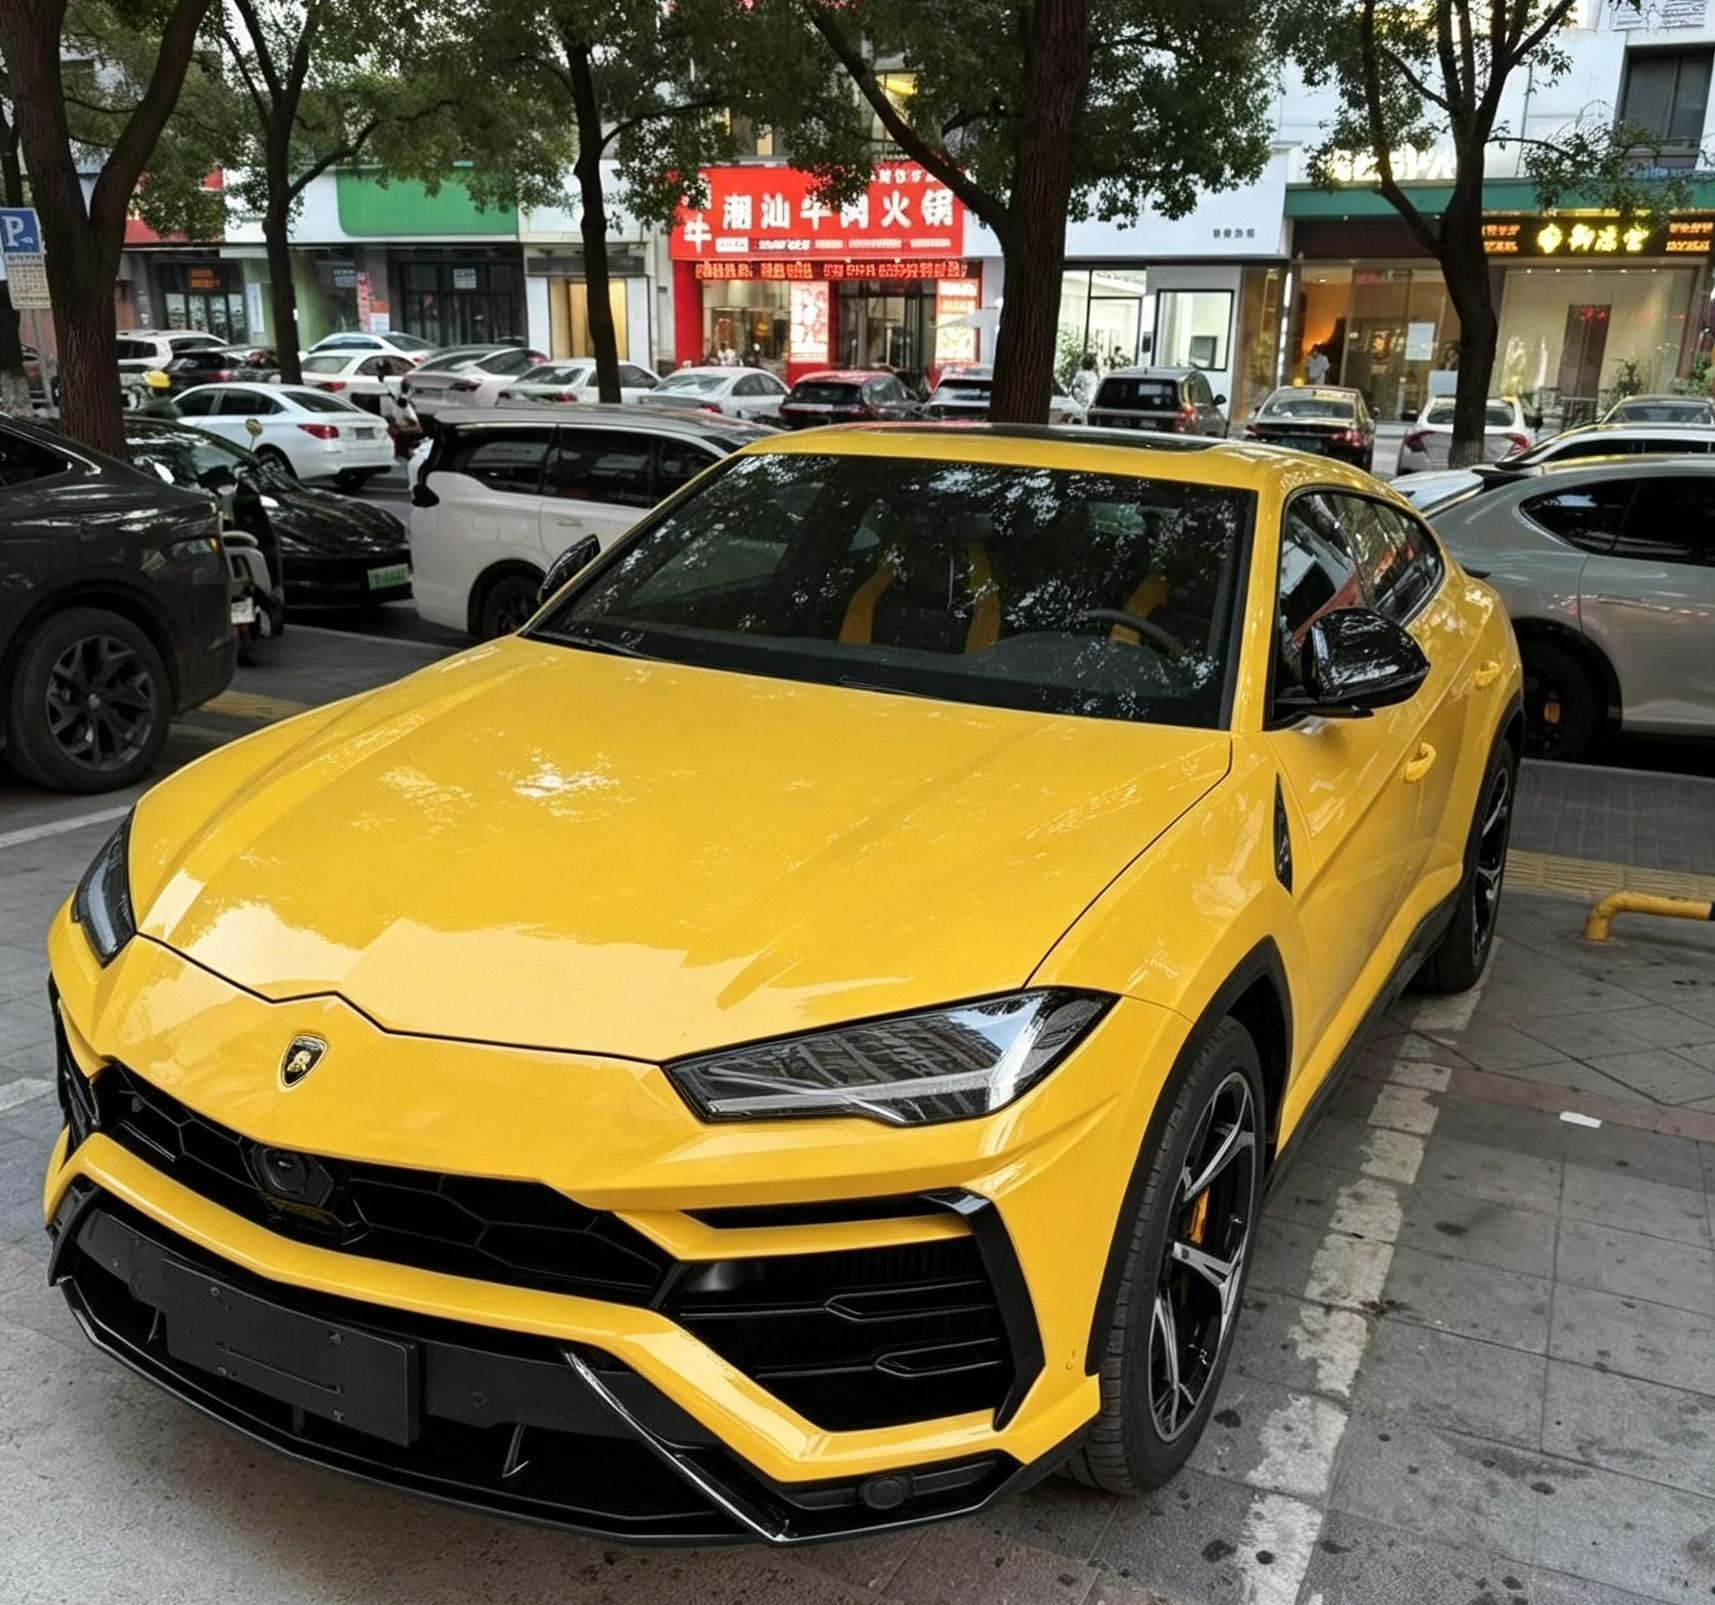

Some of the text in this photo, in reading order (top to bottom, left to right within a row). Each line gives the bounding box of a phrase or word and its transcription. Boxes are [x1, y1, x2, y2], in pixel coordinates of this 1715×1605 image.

[723, 187, 954, 232] 潮汕牛肉火锅
[2, 215, 24, 248] P
